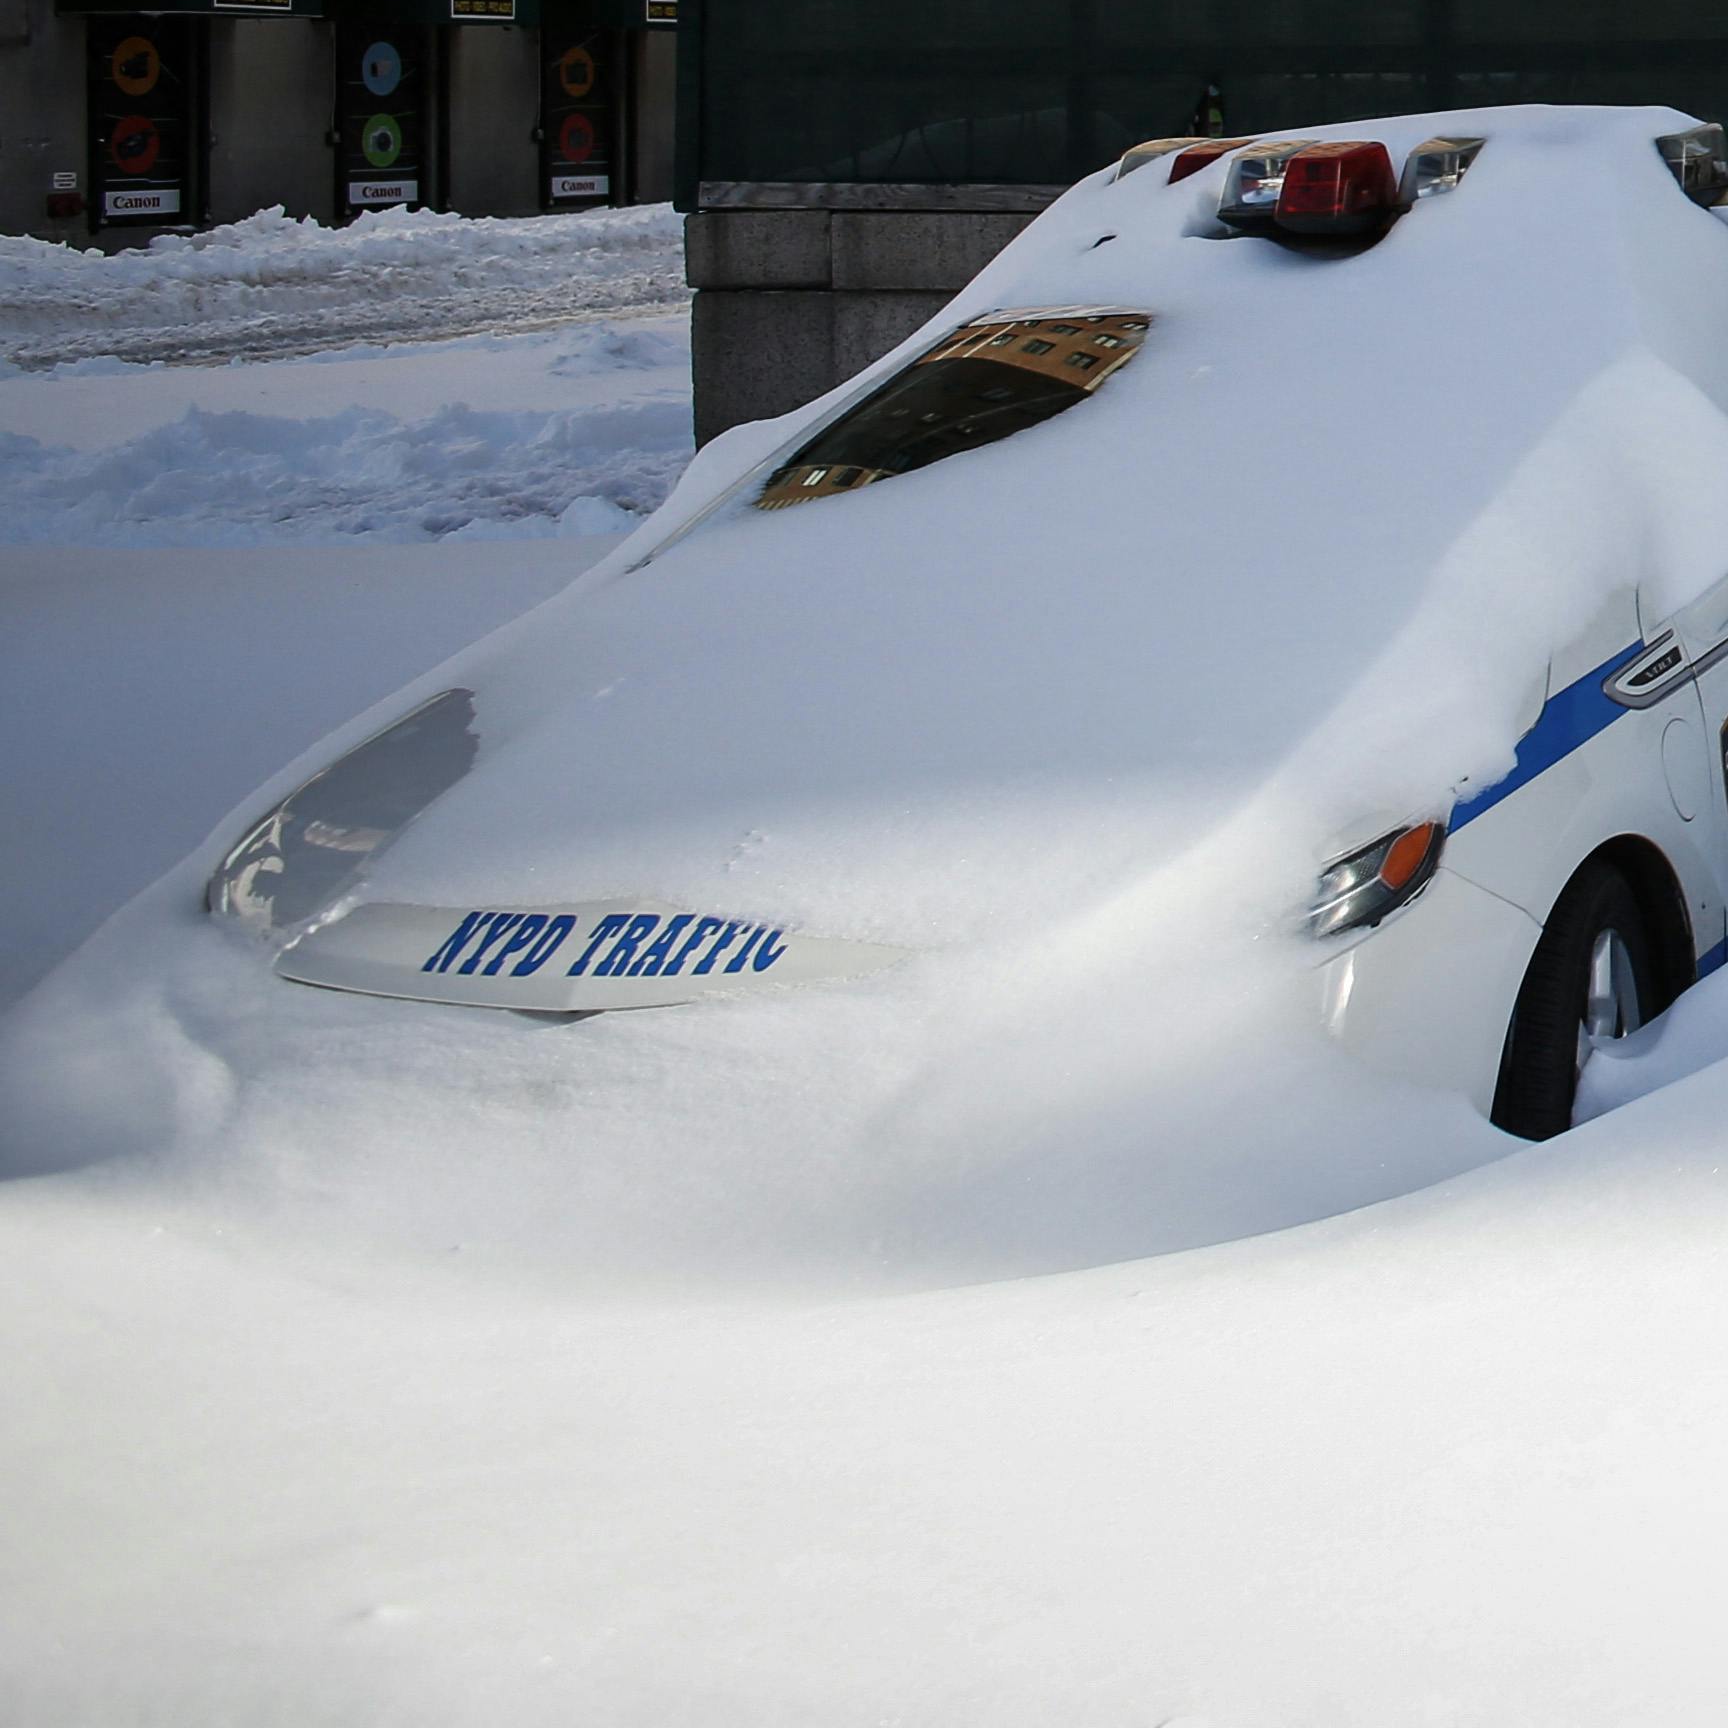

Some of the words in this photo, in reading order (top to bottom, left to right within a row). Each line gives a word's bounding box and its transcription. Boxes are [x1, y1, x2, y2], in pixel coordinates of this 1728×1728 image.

[362, 185, 402, 199] Canon
[561, 180, 596, 192] Canon
[113, 195, 161, 209] Canon
[421, 910, 578, 977] NYPD
[566, 913, 789, 977] TRAFFIC
